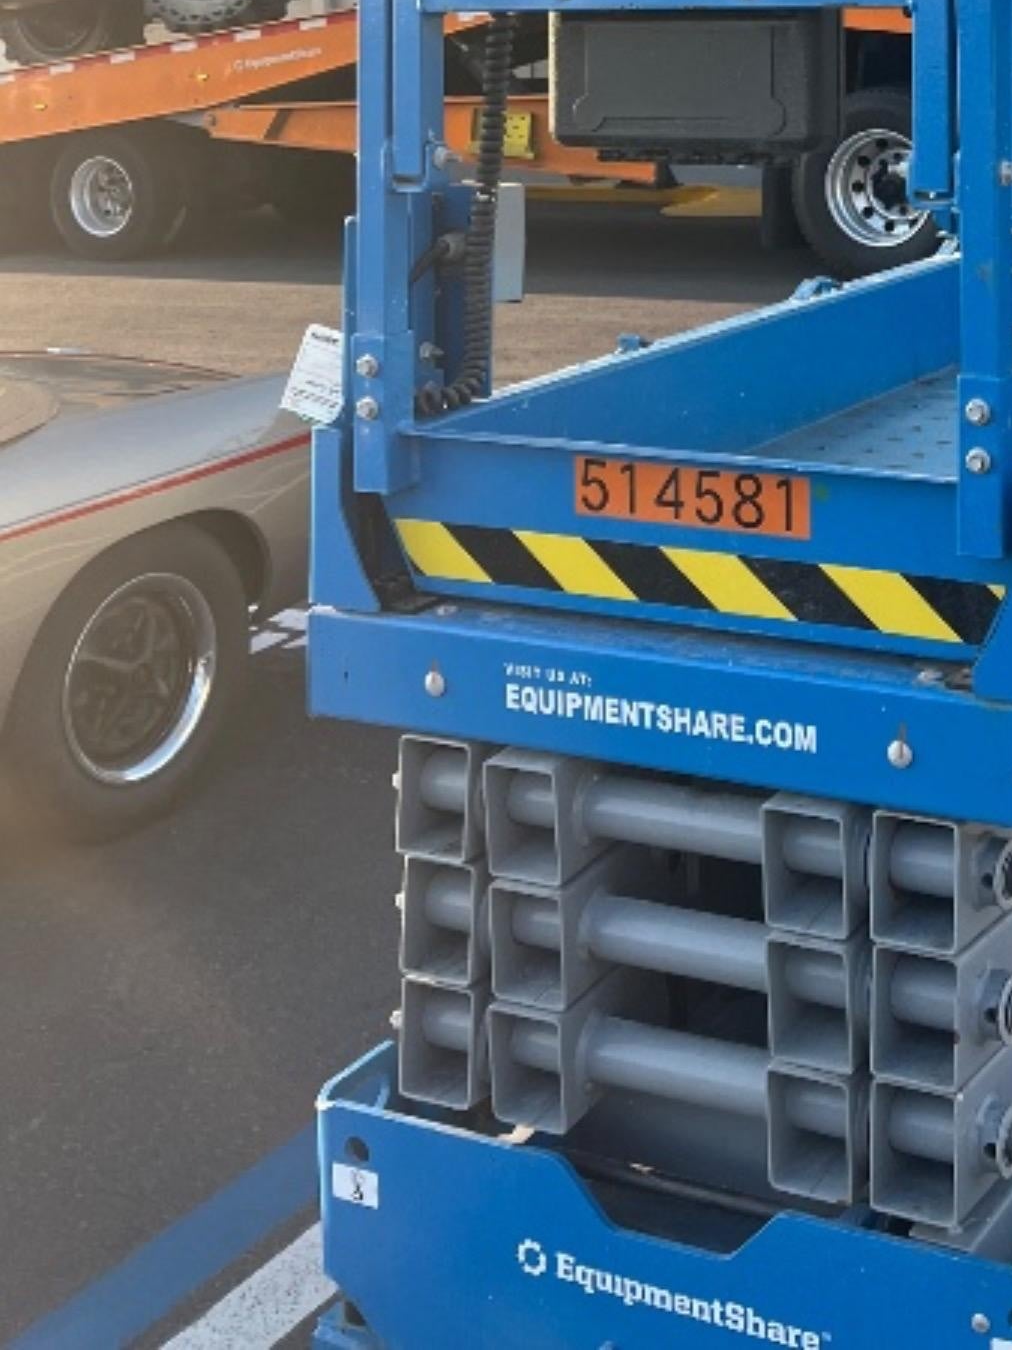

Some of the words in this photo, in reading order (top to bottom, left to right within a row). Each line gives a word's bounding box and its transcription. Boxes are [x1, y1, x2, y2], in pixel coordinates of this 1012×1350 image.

[581, 458, 794, 532] 514581
[545, 668, 566, 683] US
[569, 671, 593, 688] AT:
[505, 683, 818, 754] EQUIPMENTSHARE.COM
[555, 1252, 821, 1350] EquipmentShare
